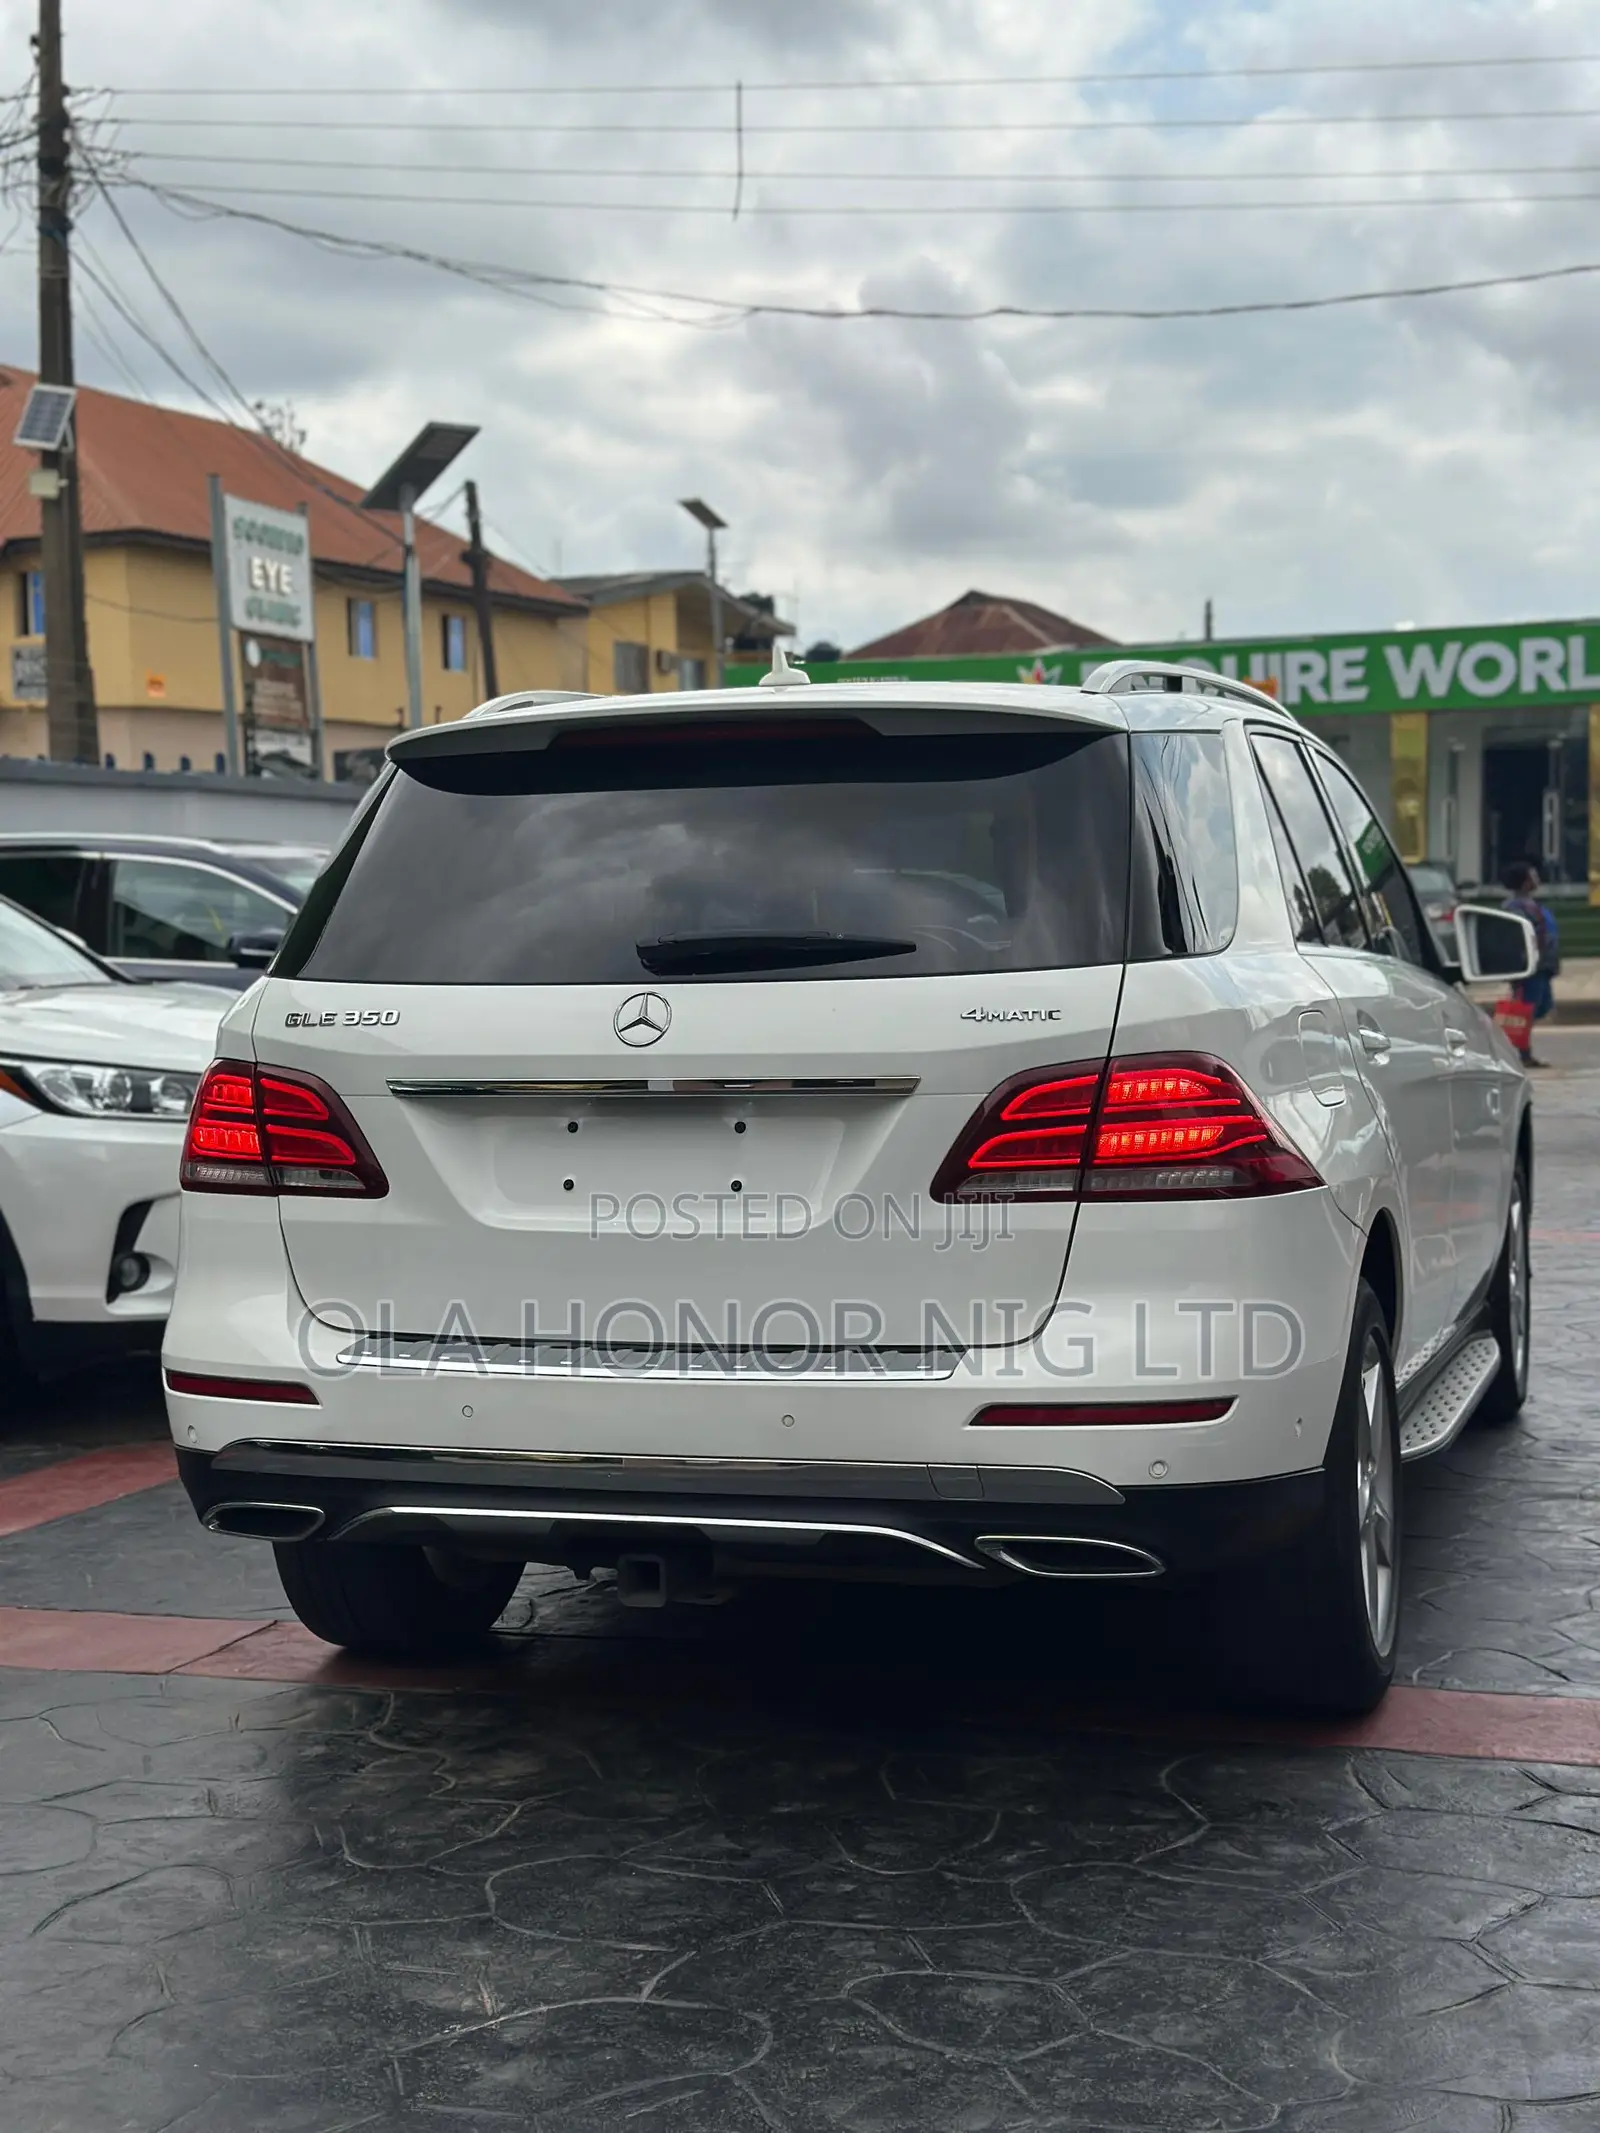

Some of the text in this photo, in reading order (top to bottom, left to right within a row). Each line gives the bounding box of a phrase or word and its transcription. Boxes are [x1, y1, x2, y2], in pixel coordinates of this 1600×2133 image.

[250, 556, 292, 596] EYE
[1079, 646, 1370, 704] UIRE
[285, 1009, 400, 1028] GLE 350
[961, 1007, 1062, 1022] 4MATIC
